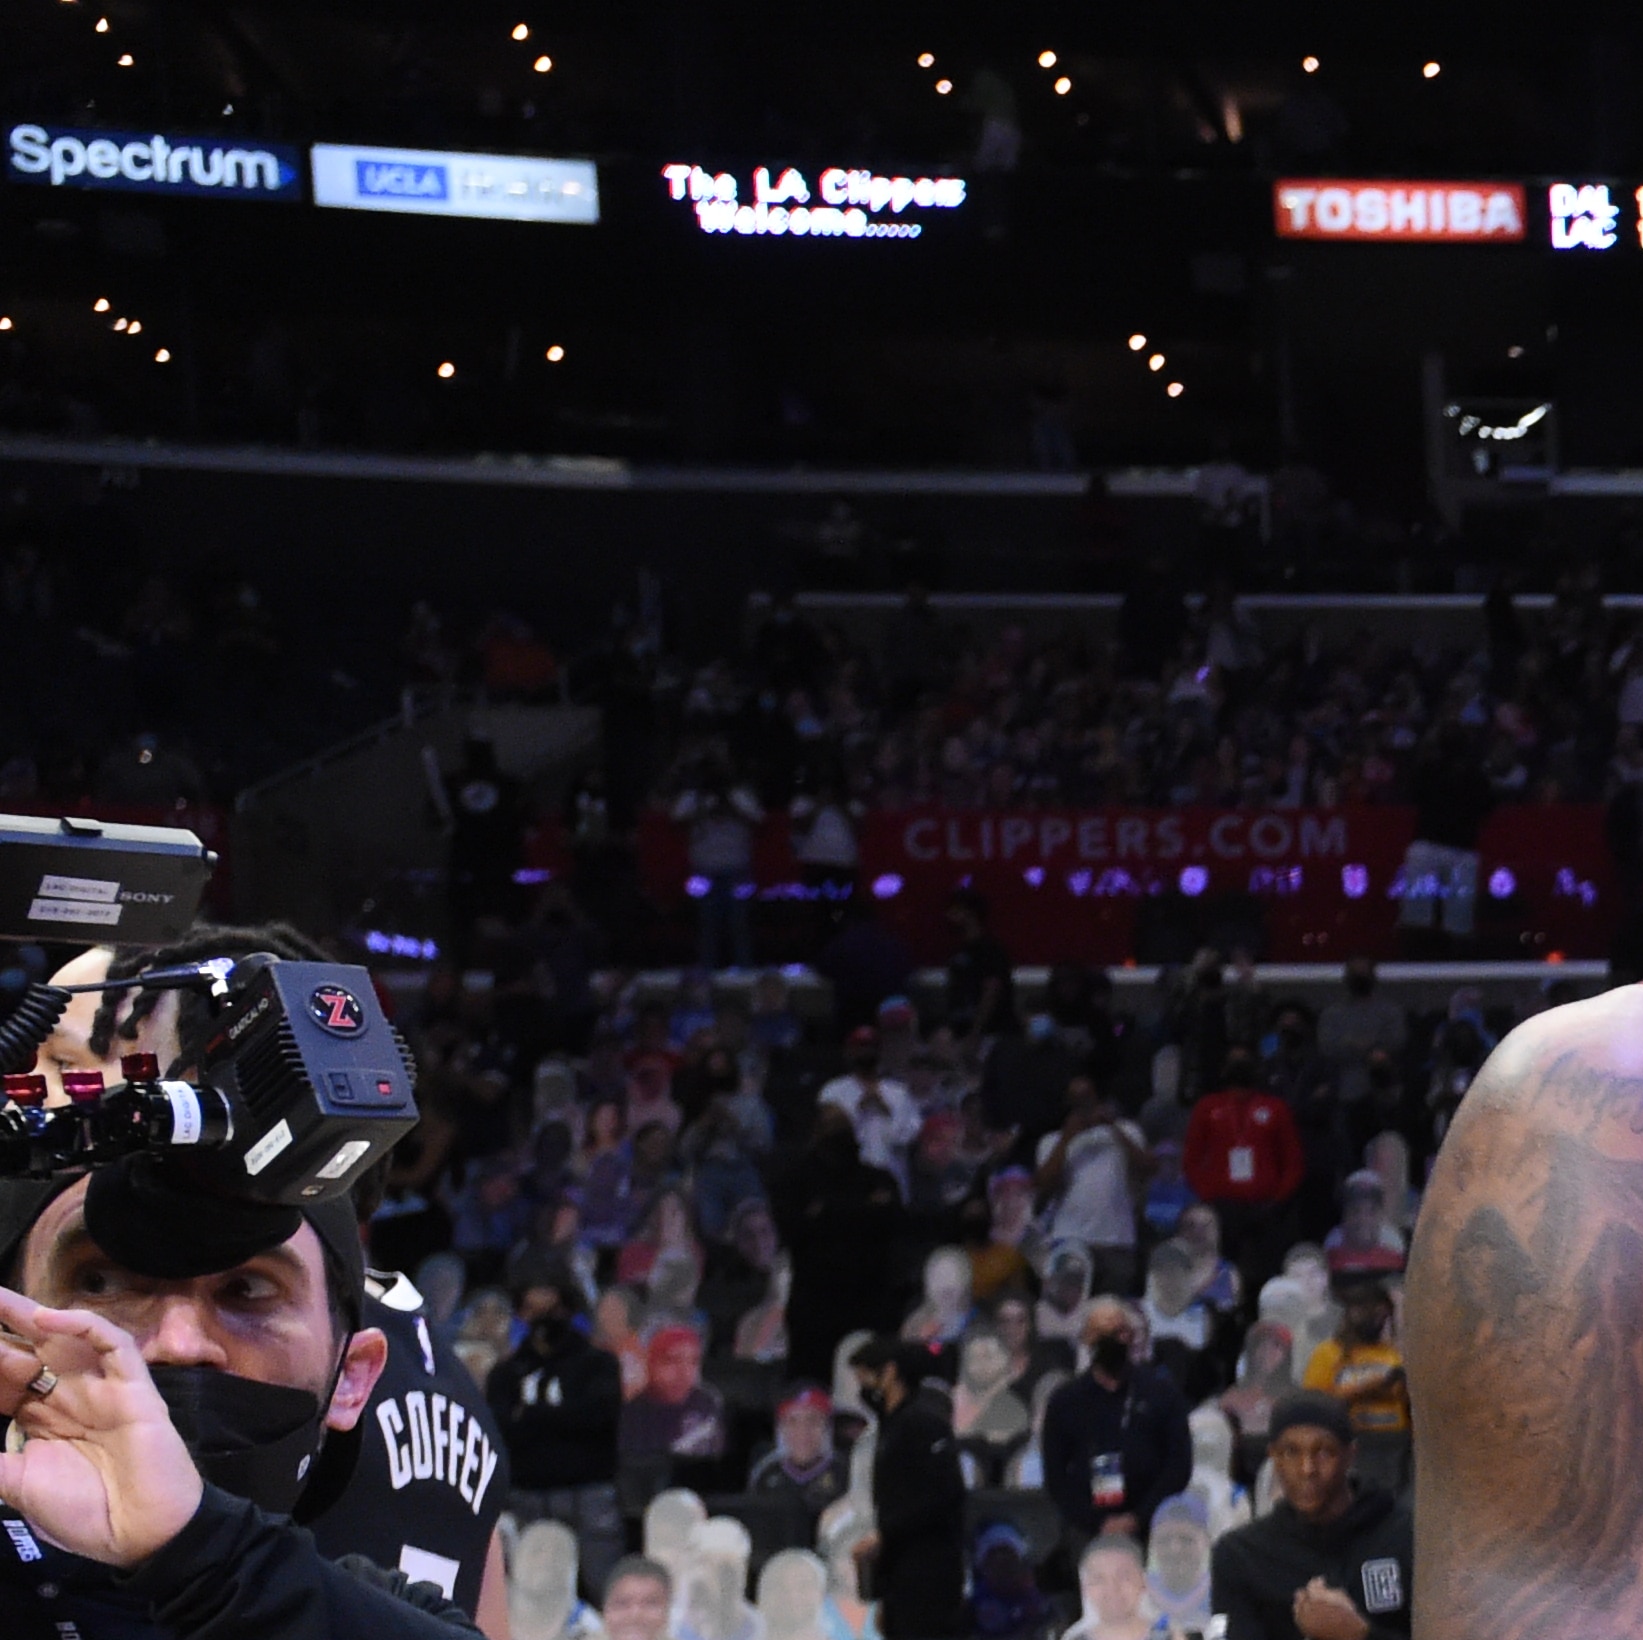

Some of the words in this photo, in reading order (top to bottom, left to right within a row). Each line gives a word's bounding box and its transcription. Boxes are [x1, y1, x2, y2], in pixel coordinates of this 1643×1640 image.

[9, 124, 281, 189] Spectrum
[662, 164, 738, 201] The
[754, 166, 811, 203] LA
[1280, 188, 1520, 234] TOSHIBA
[902, 814, 1348, 860] CLIPPERS.COM
[119, 890, 175, 904] SONY
[318, 994, 357, 1027] Z
[375, 1390, 498, 1516] COFFEY
